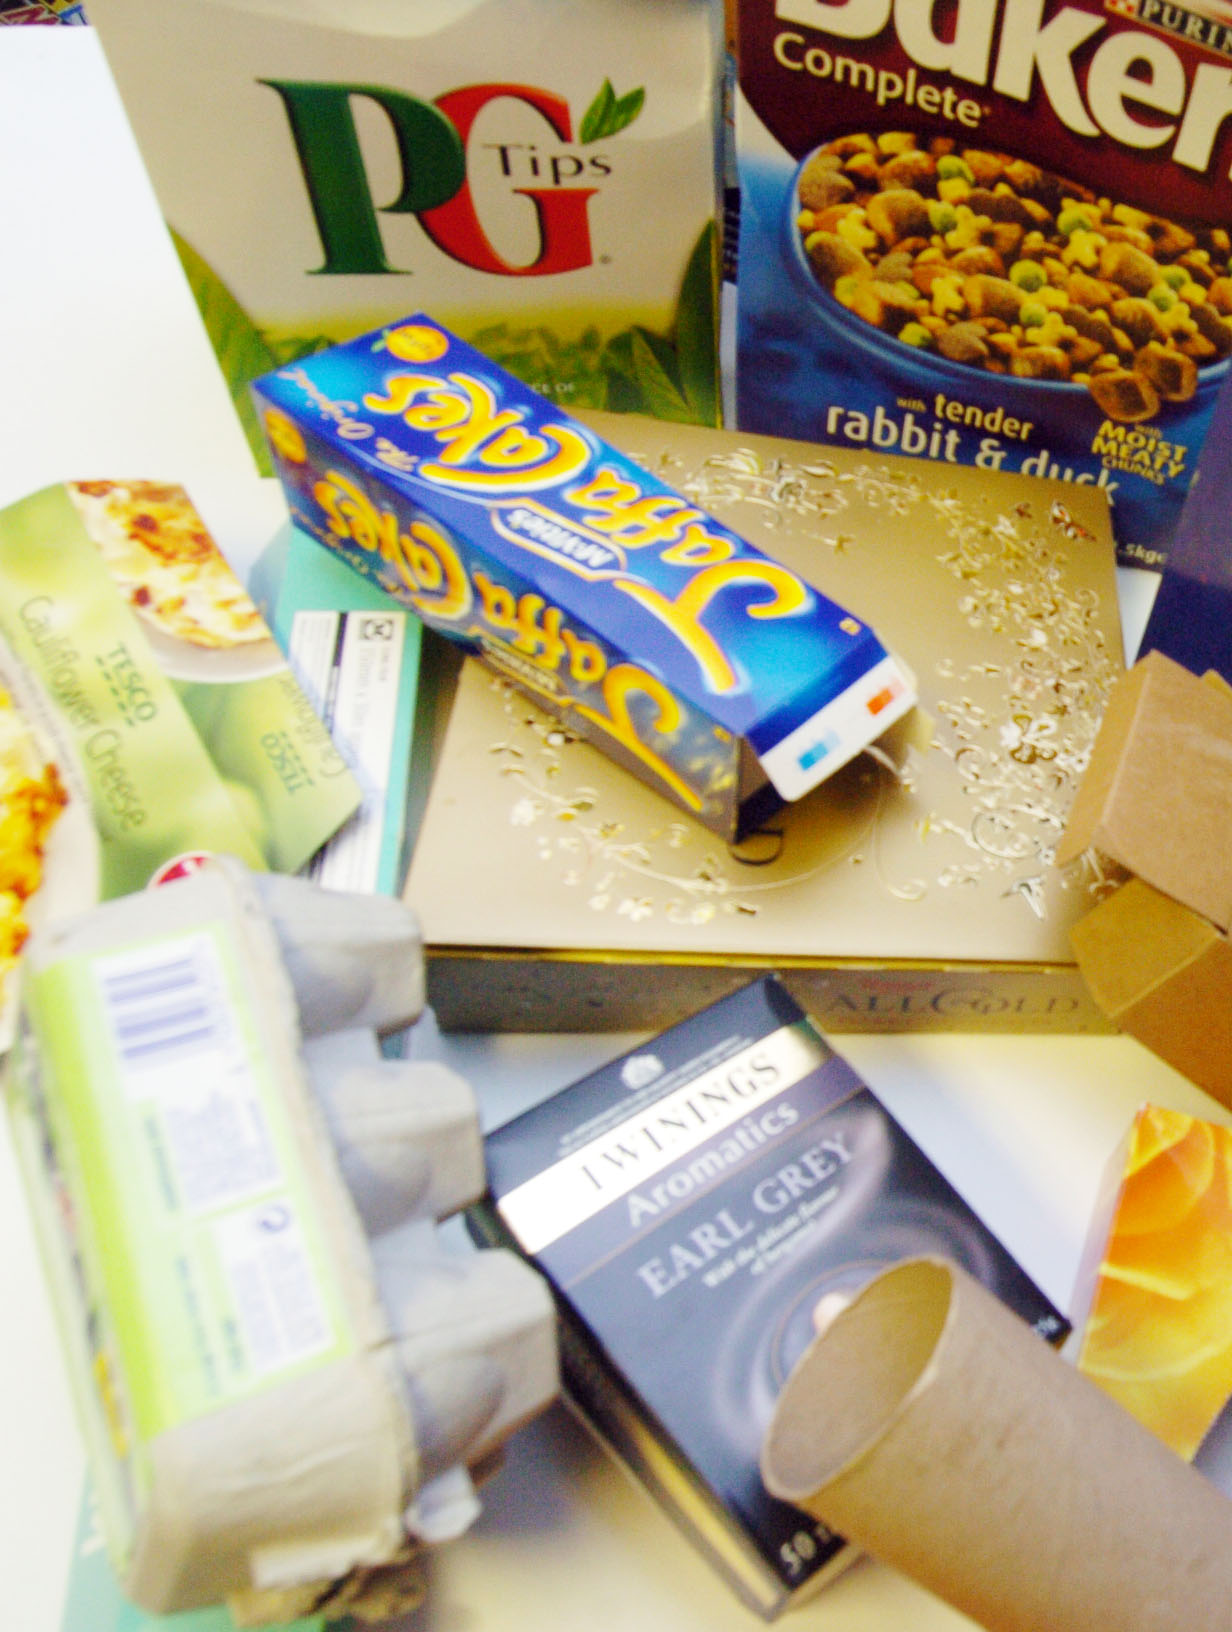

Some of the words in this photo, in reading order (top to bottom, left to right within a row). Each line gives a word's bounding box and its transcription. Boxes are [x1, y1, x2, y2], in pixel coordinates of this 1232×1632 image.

[773, 32, 980, 128] Complete
[255, 77, 600, 277] PG
[481, 143, 612, 186] Tips
[362, 371, 592, 494] Cakes
[826, 404, 962, 463] rabbit
[975, 437, 1007, 471] &
[934, 393, 1034, 441] tender
[1090, 435, 1186, 478] MEATY
[1097, 420, 1189, 463] MOIST
[313, 469, 473, 622] Cakes
[562, 467, 812, 695] Jaffa
[19, 595, 100, 730] Cauliflower
[85, 729, 147, 832] Cheese
[107, 640, 158, 723] TESCO
[471, 569, 704, 812] Jaffa
[625, 1102, 800, 1229] Aromatics
[636, 1208, 755, 1299] EARL
[753, 1131, 854, 1214] GREY
[779, 1529, 817, 1577] 50
